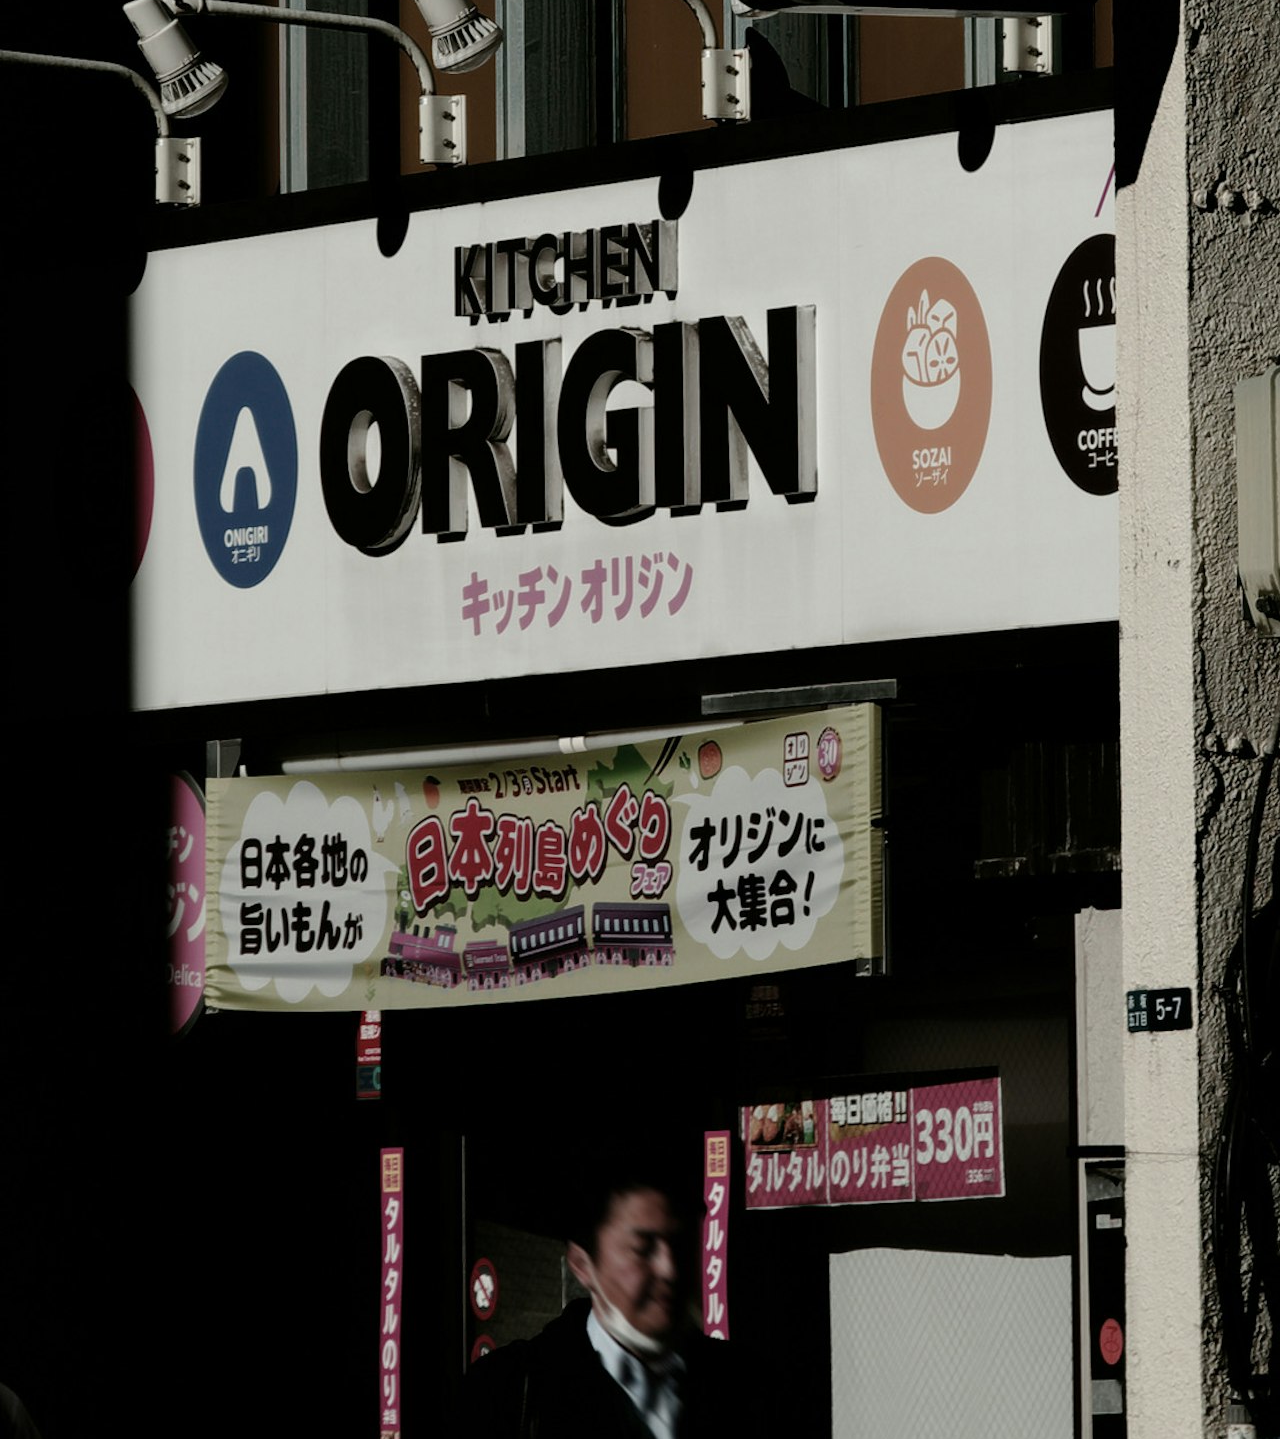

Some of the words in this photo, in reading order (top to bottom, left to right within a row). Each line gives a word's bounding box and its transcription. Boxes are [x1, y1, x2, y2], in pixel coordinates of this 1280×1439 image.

[455, 219, 678, 325] KITCHEN
[320, 304, 817, 557] ORIGIN
[912, 446, 952, 470] SOZAI
[1077, 427, 1118, 451] COFFE
[223, 525, 269, 548] ONIGIRI
[462, 564, 571, 636] キッチン
[581, 551, 693, 624] オリジン
[531, 764, 580, 796] Start
[240, 832, 368, 891] 日本各地の
[406, 782, 671, 918] 日本列島めぐり
[689, 807, 825, 872] オリジンに
[630, 860, 673, 899] フェア
[707, 869, 815, 934] 大集合!
[240, 900, 363, 956] 旨いもんが
[1155, 996, 1183, 1020] 5-7
[916, 1105, 995, 1166] 330円
